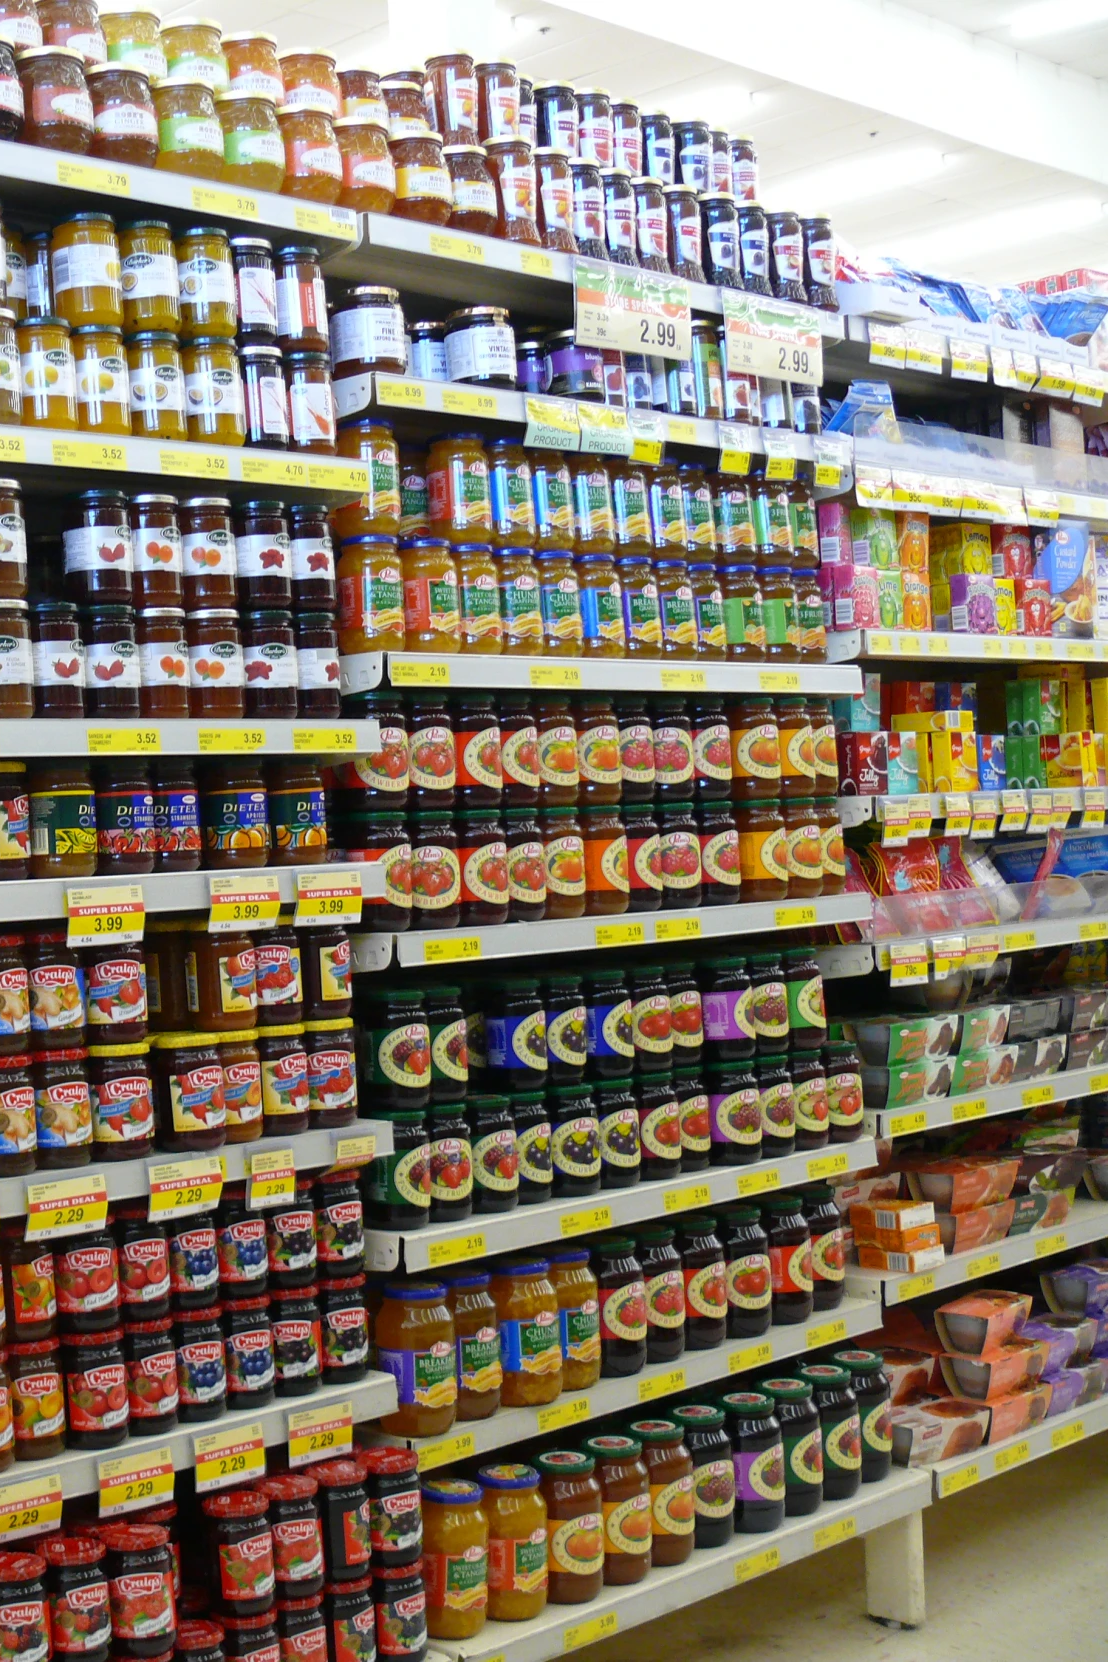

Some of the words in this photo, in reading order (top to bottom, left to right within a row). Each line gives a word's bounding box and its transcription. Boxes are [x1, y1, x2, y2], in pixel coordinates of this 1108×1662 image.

[107, 174, 127, 188] 3.79
[640, 319, 676, 347] 2.99
[779, 347, 809, 374] 2.99
[405, 387, 421, 398] 8.99
[0, 439, 20, 451] 3.52
[534, 435, 572, 448] PRODUCT
[285, 464, 303, 476] 4.70
[350, 471, 366, 483] 4.70
[909, 492, 921, 504] 95c
[977, 499, 989, 510] 95c
[964, 530, 989, 544] Lemon
[1054, 545, 1077, 557] Custard
[1055, 557, 1077, 570] Powder
[879, 581, 897, 592] Lime
[904, 583, 928, 595] Orange
[430, 667, 446, 677] 2.19
[137, 732, 156, 745] 3.52
[223, 803, 265, 815] DIETEX
[78, 906, 107, 914] SUPER
[110, 905, 132, 913] DEAL
[94, 917, 123, 932] 3.99
[627, 926, 641, 937] 2.19
[463, 940, 478, 952] 2.19
[904, 964, 918, 976] 79c
[161, 1181, 189, 1190] SUPER
[191, 1176, 213, 1185] DEAL
[176, 1189, 202, 1205] 2.29
[695, 1188, 708, 1200] 2.19
[456, 1437, 471, 1449] 3.99
[220, 1456, 246, 1474] 2.29
[126, 1481, 153, 1499] 2.29
[120, 1574, 162, 1594] Craig's
[600, 1617, 614, 1628] 3.99
